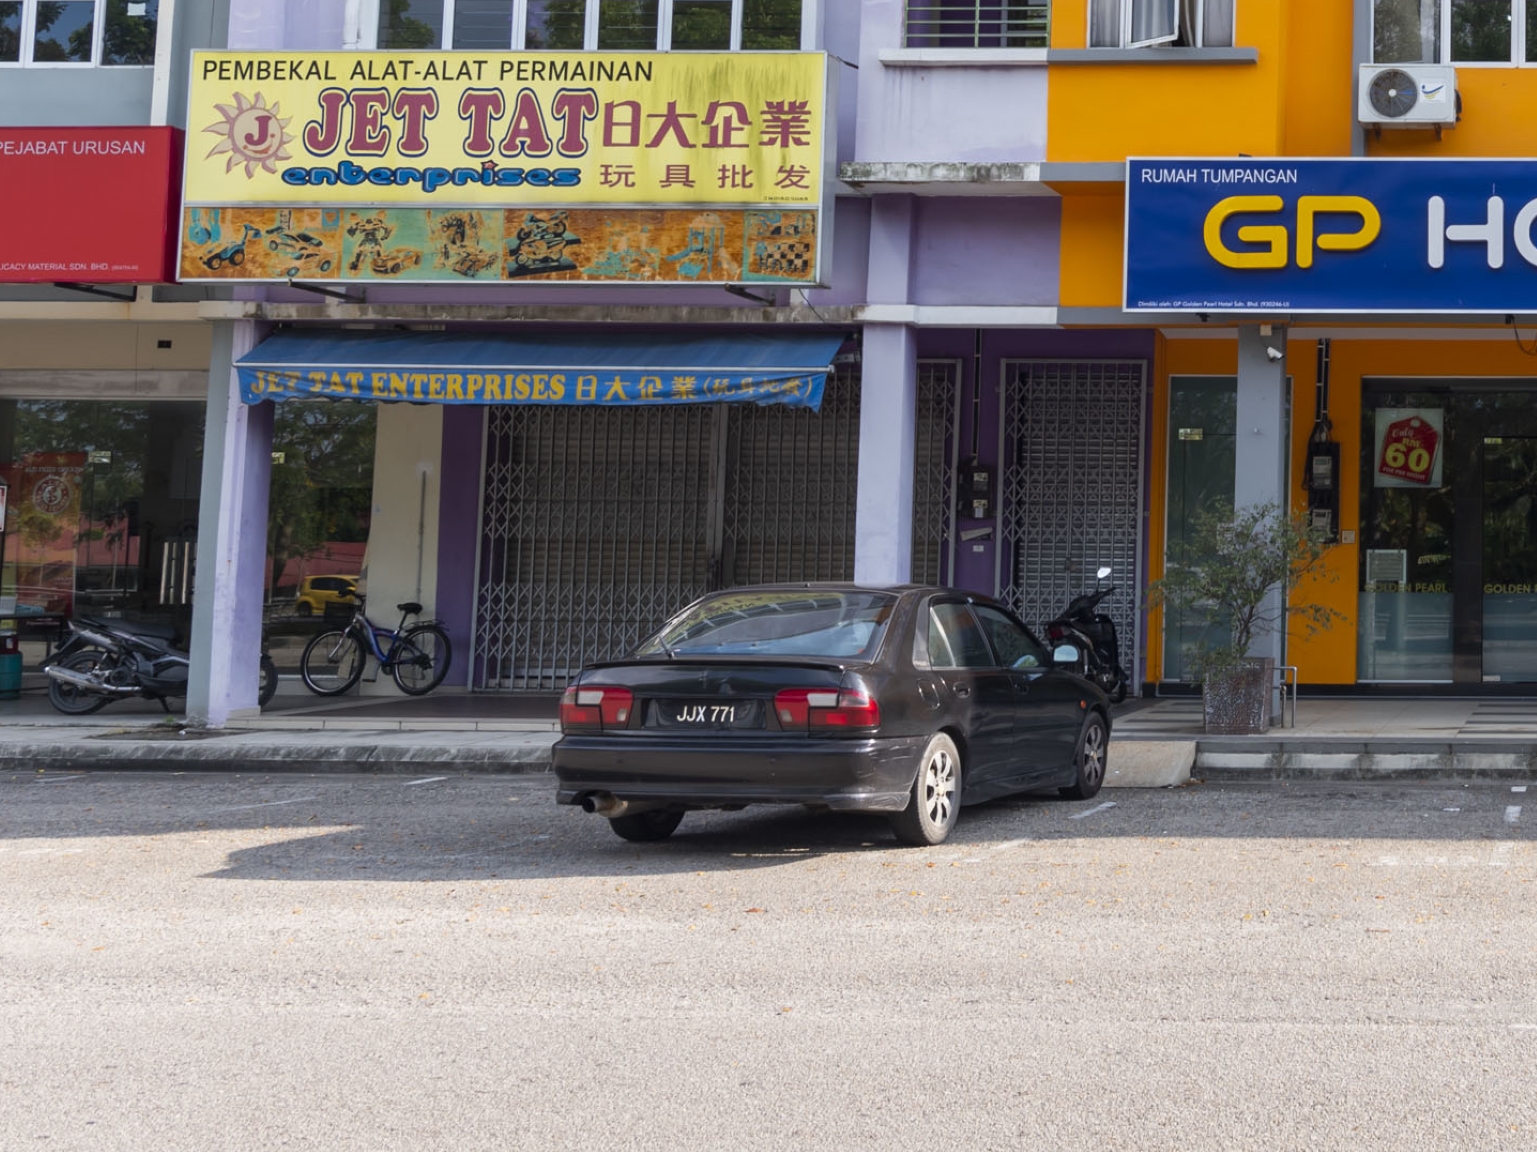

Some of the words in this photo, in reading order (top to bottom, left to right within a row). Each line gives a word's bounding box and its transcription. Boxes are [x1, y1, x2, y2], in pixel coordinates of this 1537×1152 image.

[203, 60, 336, 80] PEMBEKAL
[350, 60, 488, 81] ALAT-ALAT
[500, 61, 653, 81] PERMAINAN
[303, 87, 440, 158] JET
[458, 87, 598, 158] TAT
[602, 100, 812, 149] 日大企業
[72, 141, 146, 155] URUSAN
[281, 160, 581, 193] enterprises
[600, 164, 811, 189] 玩具批发
[1141, 168, 1197, 184] RUMAH
[1201, 168, 1297, 184] TUMPANGAN
[1203, 195, 1381, 269] GP
[0, 262, 26, 271] ICACY
[28, 262, 67, 270] MATERIAL
[251, 371, 301, 394] JET
[308, 371, 364, 394] TAT
[371, 372, 566, 400] ENTERPRISES
[1385, 442, 1430, 473] 60
[1415, 583, 1447, 593] PEARL
[1484, 584, 1531, 594] GOLDEN
[677, 705, 706, 722] JJX
[711, 706, 734, 722] 771
